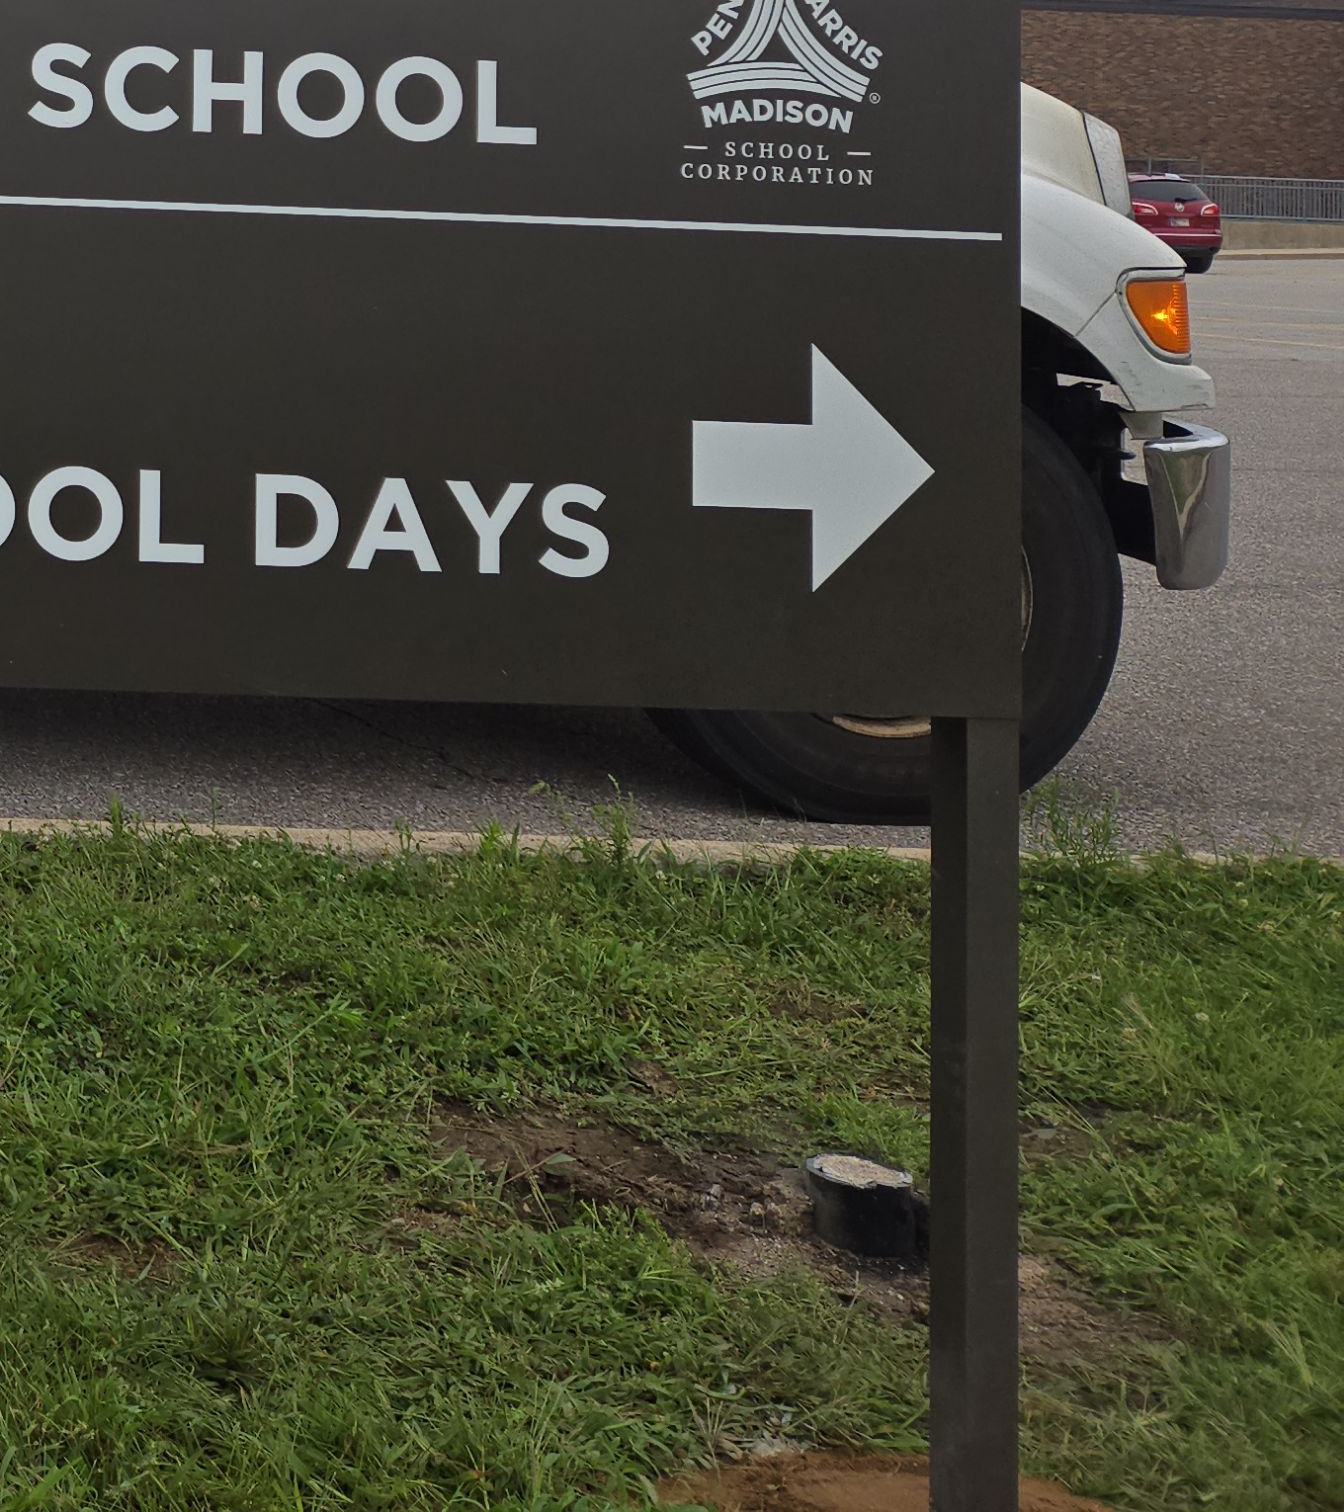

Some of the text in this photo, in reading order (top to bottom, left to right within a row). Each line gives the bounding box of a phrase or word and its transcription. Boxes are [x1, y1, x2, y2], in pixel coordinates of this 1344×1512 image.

[27, 42, 538, 146] SCHOOL
[700, 98, 854, 134] MADISON
[724, 141, 830, 161] SCHOOL
[679, 162, 874, 186] CORPORATION
[255, 473, 610, 578] DAYS
